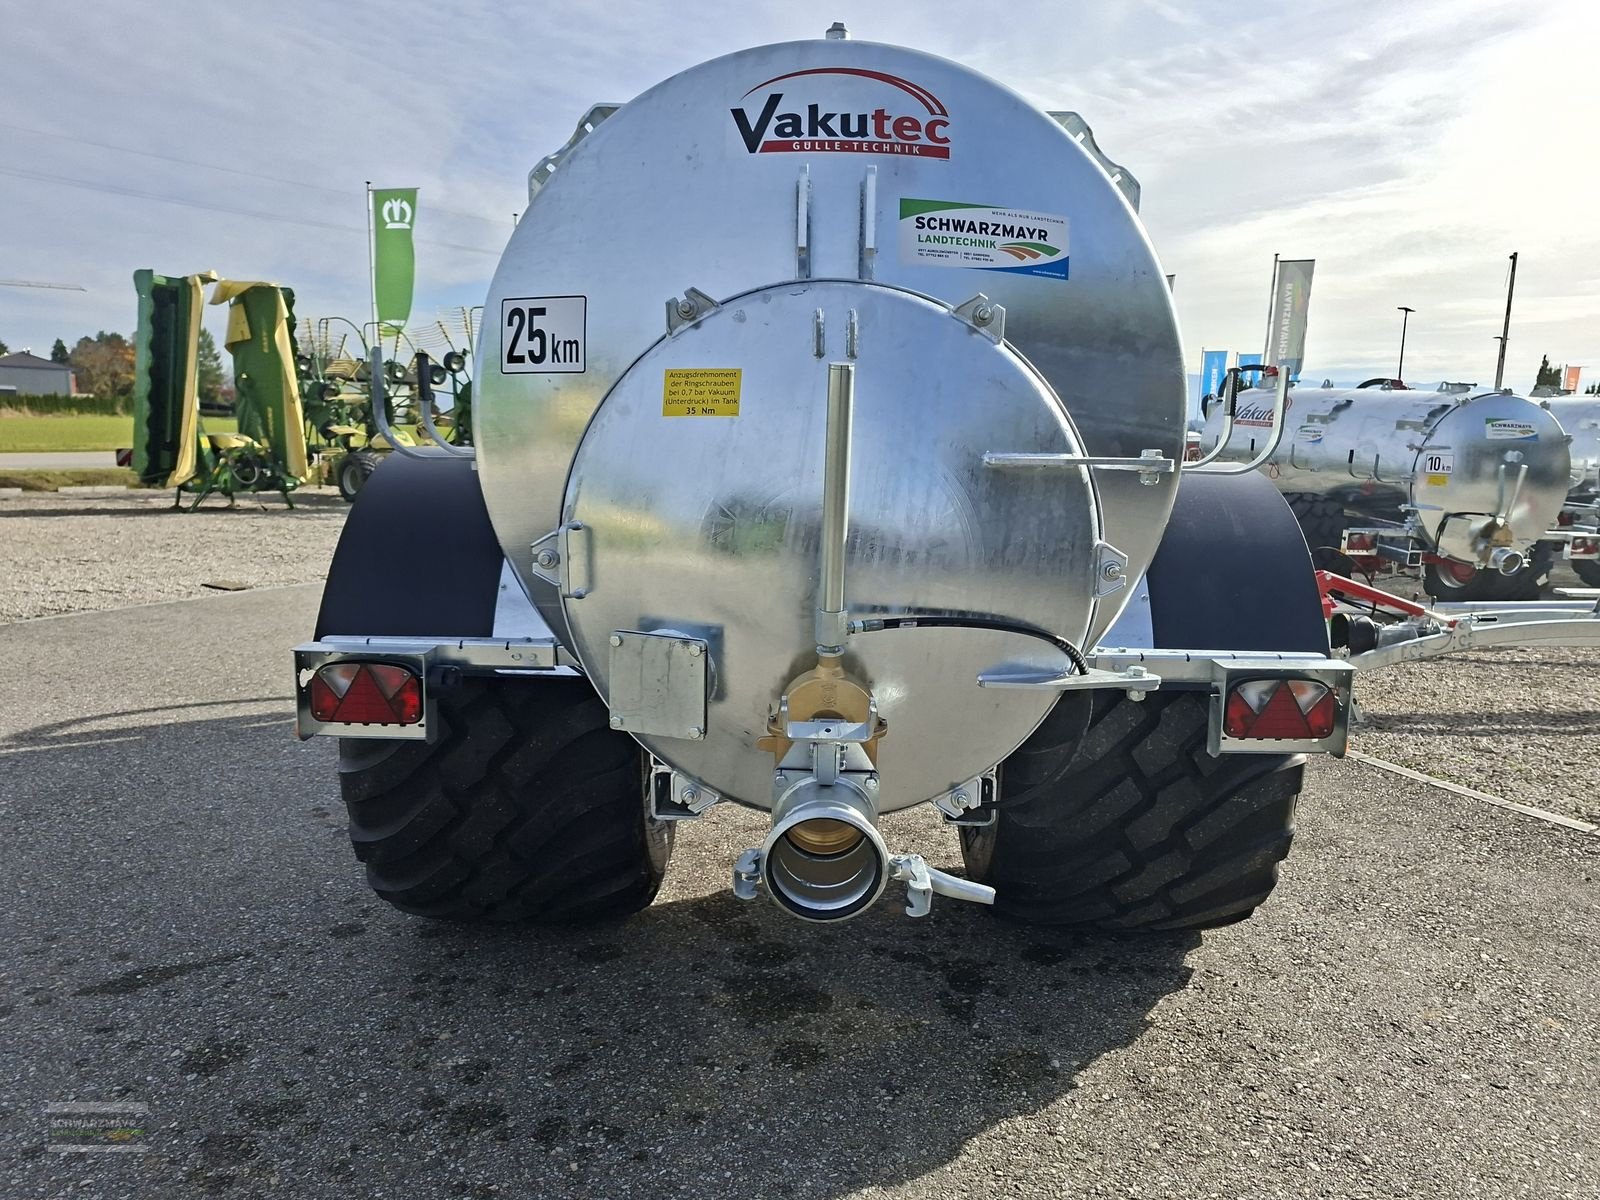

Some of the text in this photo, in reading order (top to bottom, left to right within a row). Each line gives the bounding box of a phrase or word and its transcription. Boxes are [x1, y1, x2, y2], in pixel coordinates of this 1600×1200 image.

[730, 93, 951, 153] Vakutec
[792, 141, 920, 154] GÜLLE-TECHNIK
[915, 216, 1048, 242] SCHWARZMAYR
[917, 234, 997, 249] LANDTECHNIK
[1278, 283, 1293, 360] SCHWARZMAYR
[507, 307, 579, 364] 25 km
[684, 380, 735, 388] Ringschrauben
[1235, 402, 1275, 421] Vakute
[1428, 456, 1451, 472] 10 km
